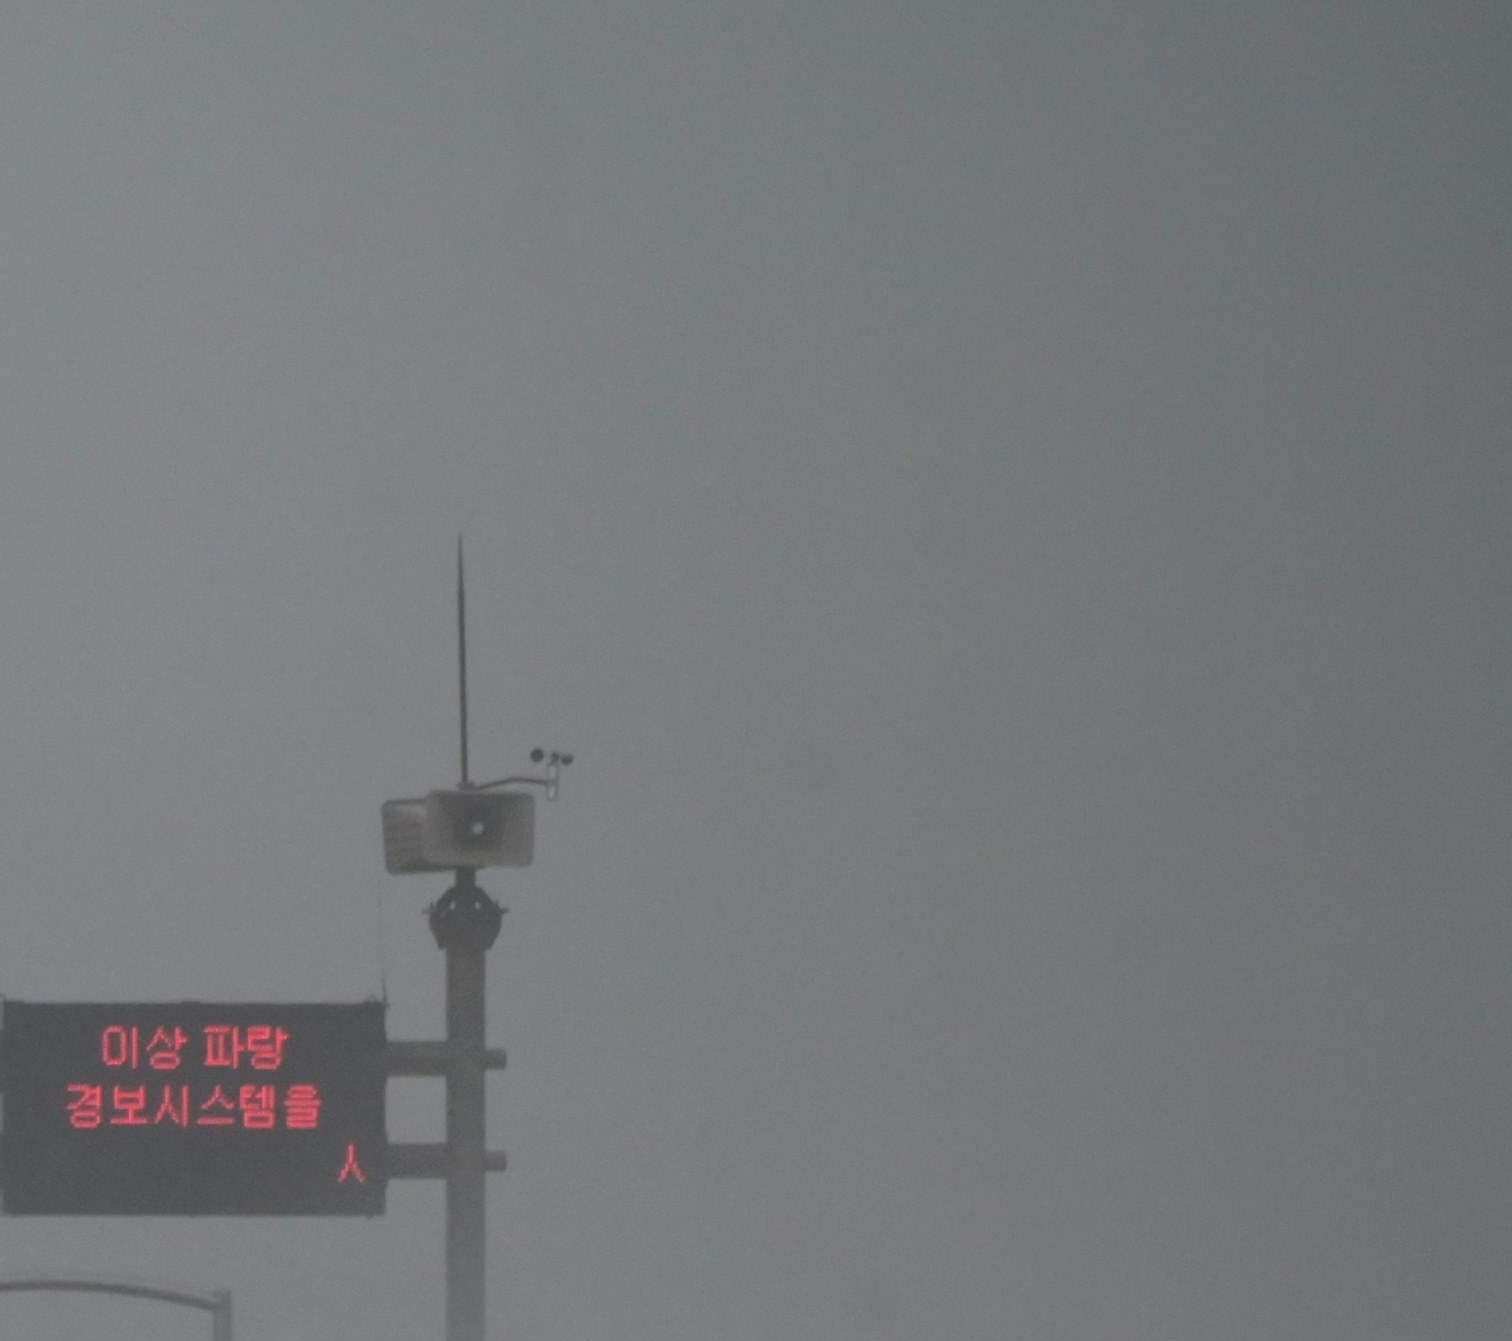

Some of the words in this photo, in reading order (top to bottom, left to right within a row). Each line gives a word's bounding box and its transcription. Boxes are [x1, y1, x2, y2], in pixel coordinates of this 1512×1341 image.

[102, 1025, 188, 1070] 이상
[204, 1025, 289, 1070] 파랑
[67, 1084, 322, 1129] 경보시스템을
